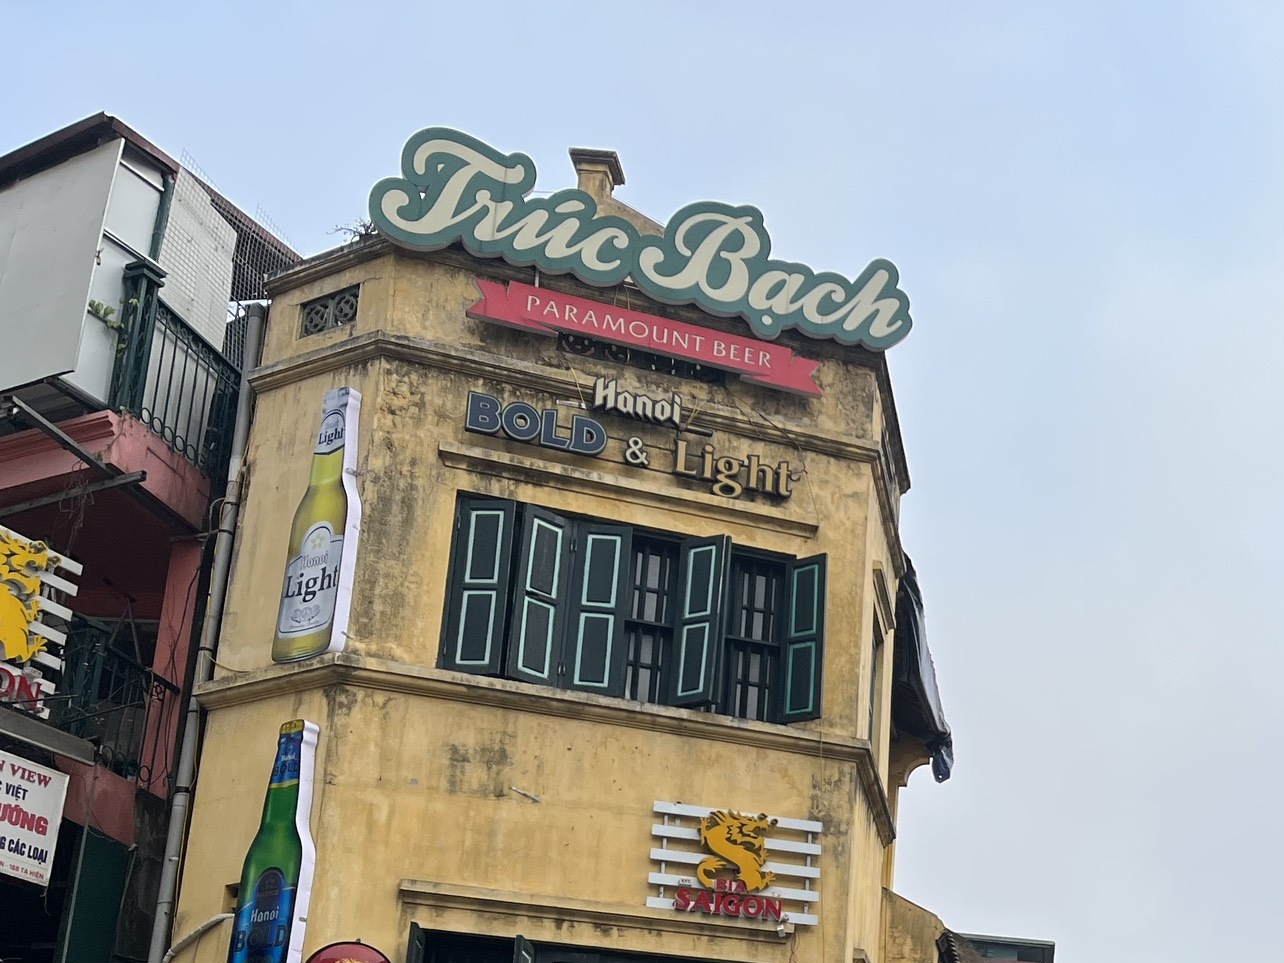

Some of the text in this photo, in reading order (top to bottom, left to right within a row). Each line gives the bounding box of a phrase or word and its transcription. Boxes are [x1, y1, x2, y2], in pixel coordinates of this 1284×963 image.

[381, 138, 903, 340] Trúc Bạch
[525, 295, 772, 369] PARAMOUNT BEER
[593, 376, 683, 427] Hanoi
[317, 425, 344, 446] Light
[465, 391, 793, 498] BOLD & Light
[284, 565, 338, 603] Light
[10, 763, 52, 788] VIEW
[5, 782, 28, 801] VIỆT
[8, 838, 27, 856] CÁC
[27, 847, 48, 865] LOẠI
[713, 878, 747, 893] BIA
[250, 905, 280, 923] Hanoi
[673, 886, 784, 922] SAIGON
